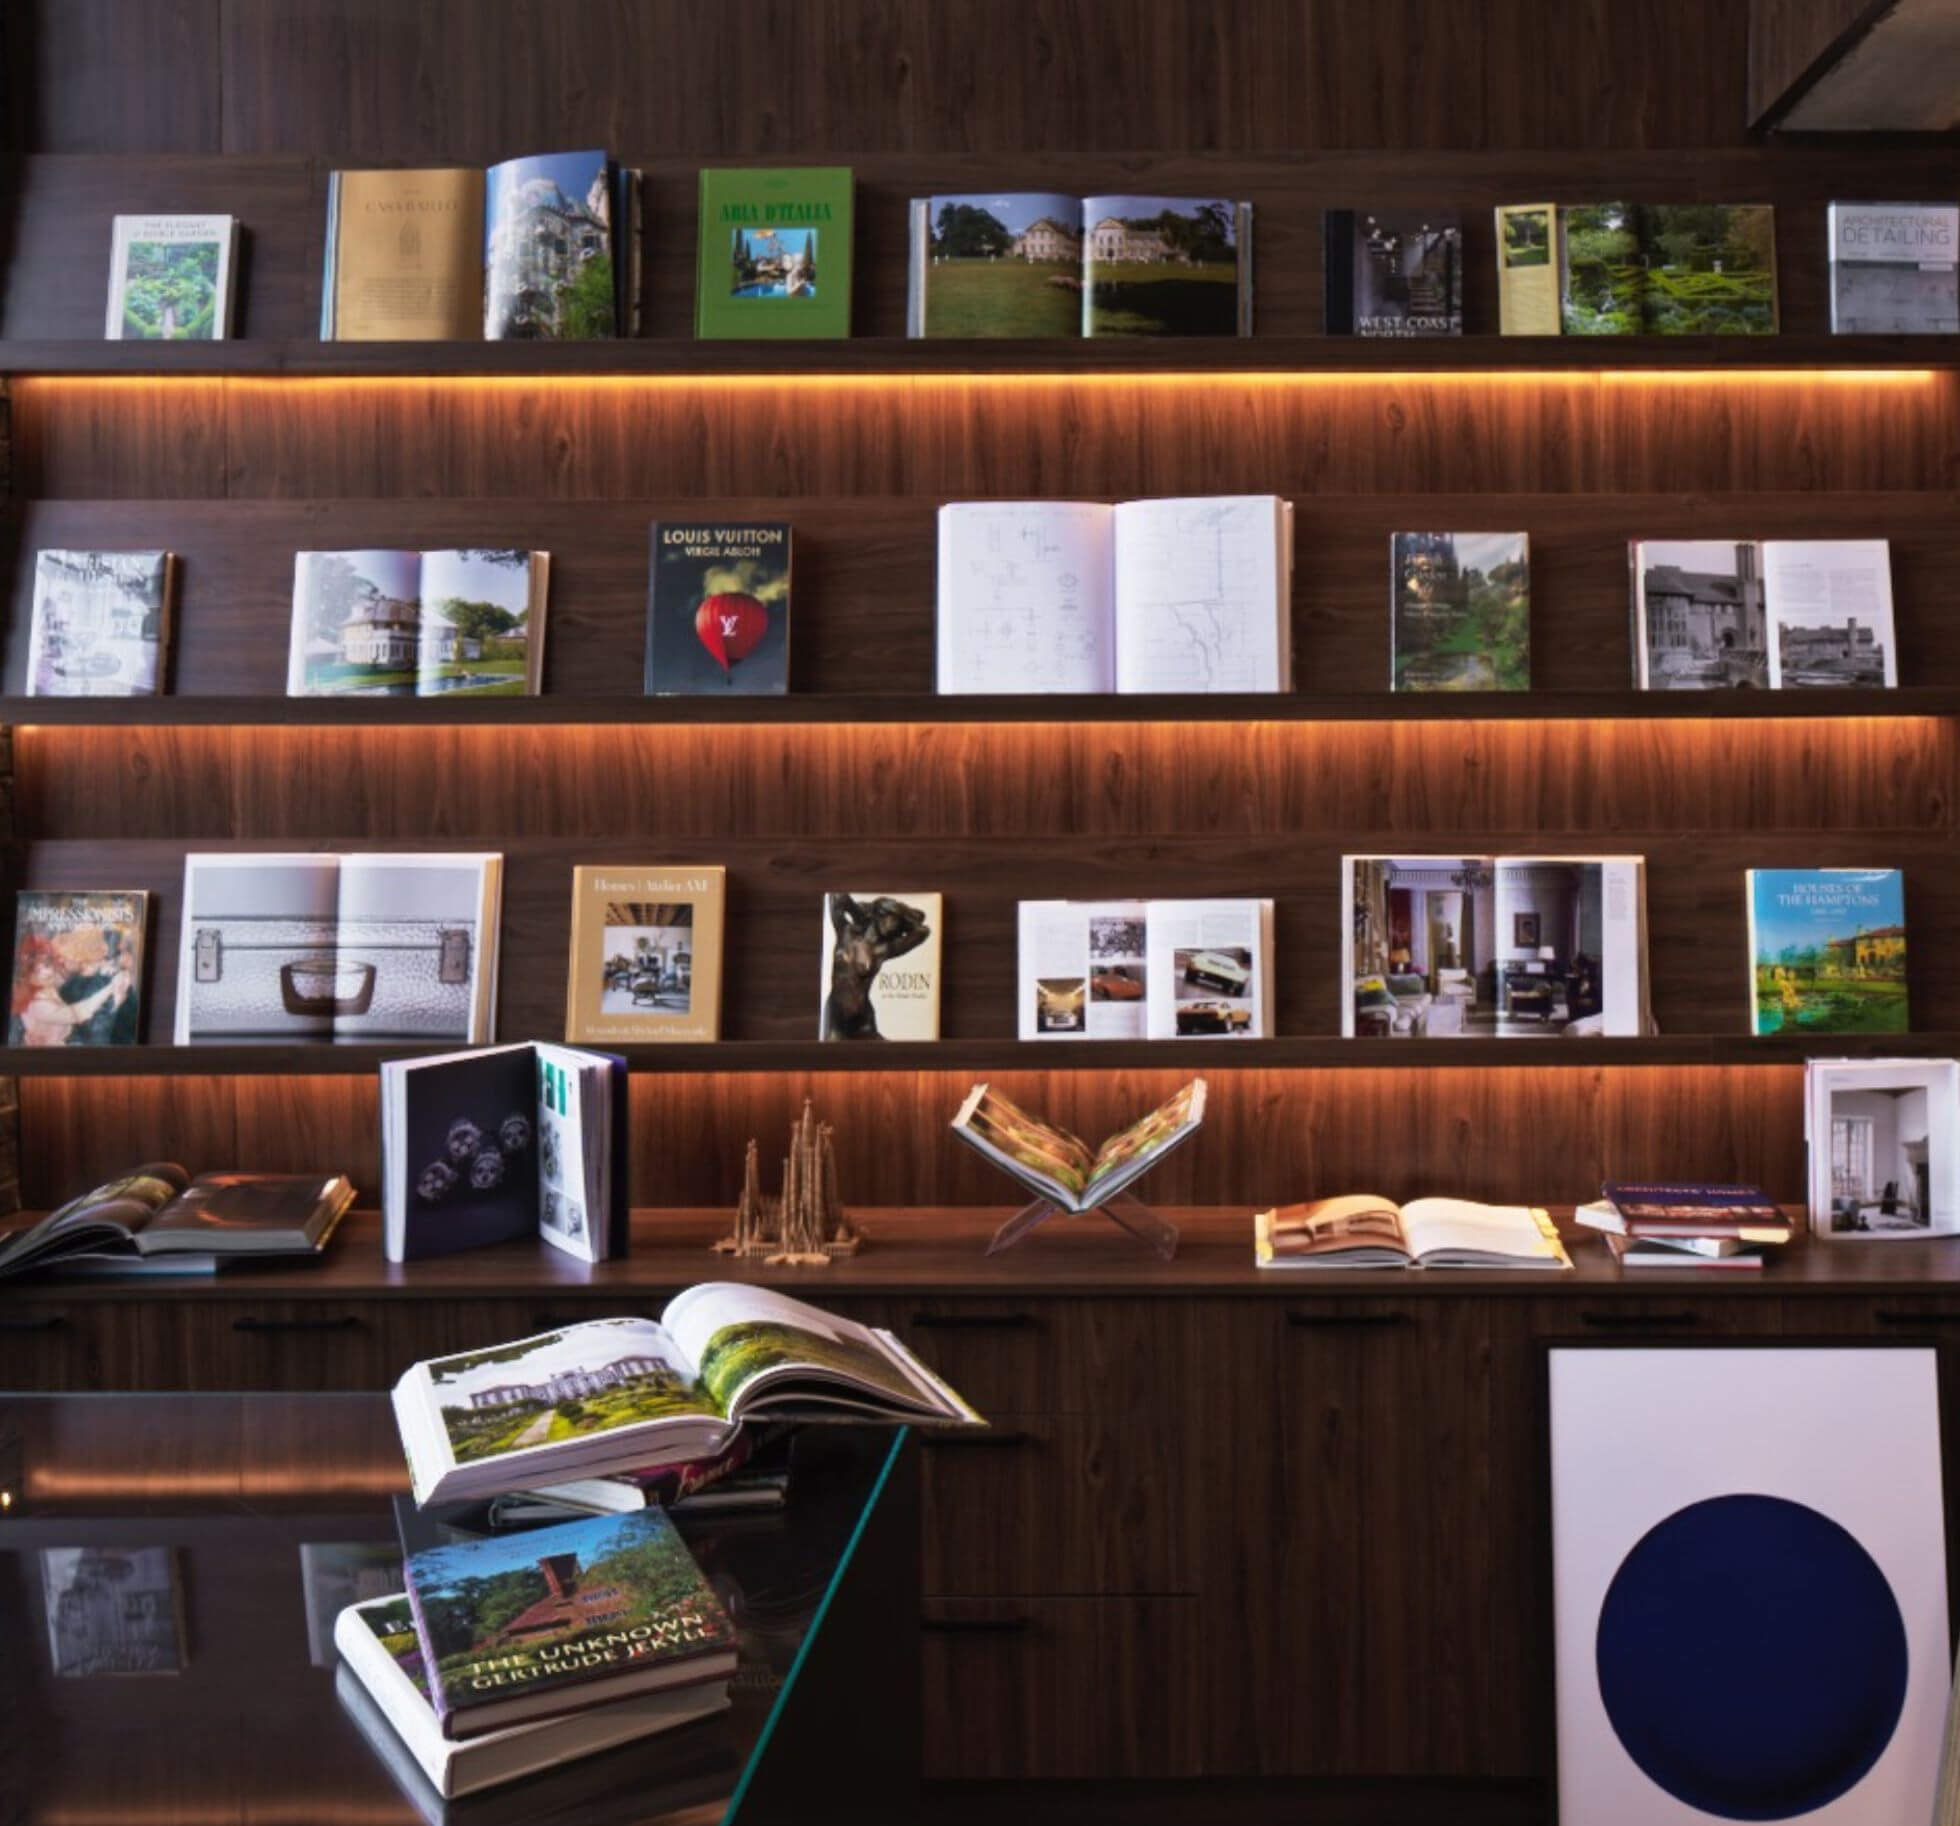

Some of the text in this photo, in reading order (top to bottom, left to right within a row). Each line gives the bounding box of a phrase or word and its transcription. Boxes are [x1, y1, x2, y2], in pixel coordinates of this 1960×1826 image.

[1843, 227, 1951, 245] DETAILING
[1360, 316, 1461, 329] WEST COAST
[663, 528, 783, 545] LOUIS VUITTON
[685, 546, 762, 557] VIRGIL ABLOH
[1792, 883, 1862, 894] HOUSES OF
[1776, 893, 1879, 907] THE HAMPTONS
[880, 972, 931, 991] RODIN
[472, 1613, 703, 1674] THE UNKNOWN
[471, 1626, 709, 1690] GERTRUDE JEKYLL
